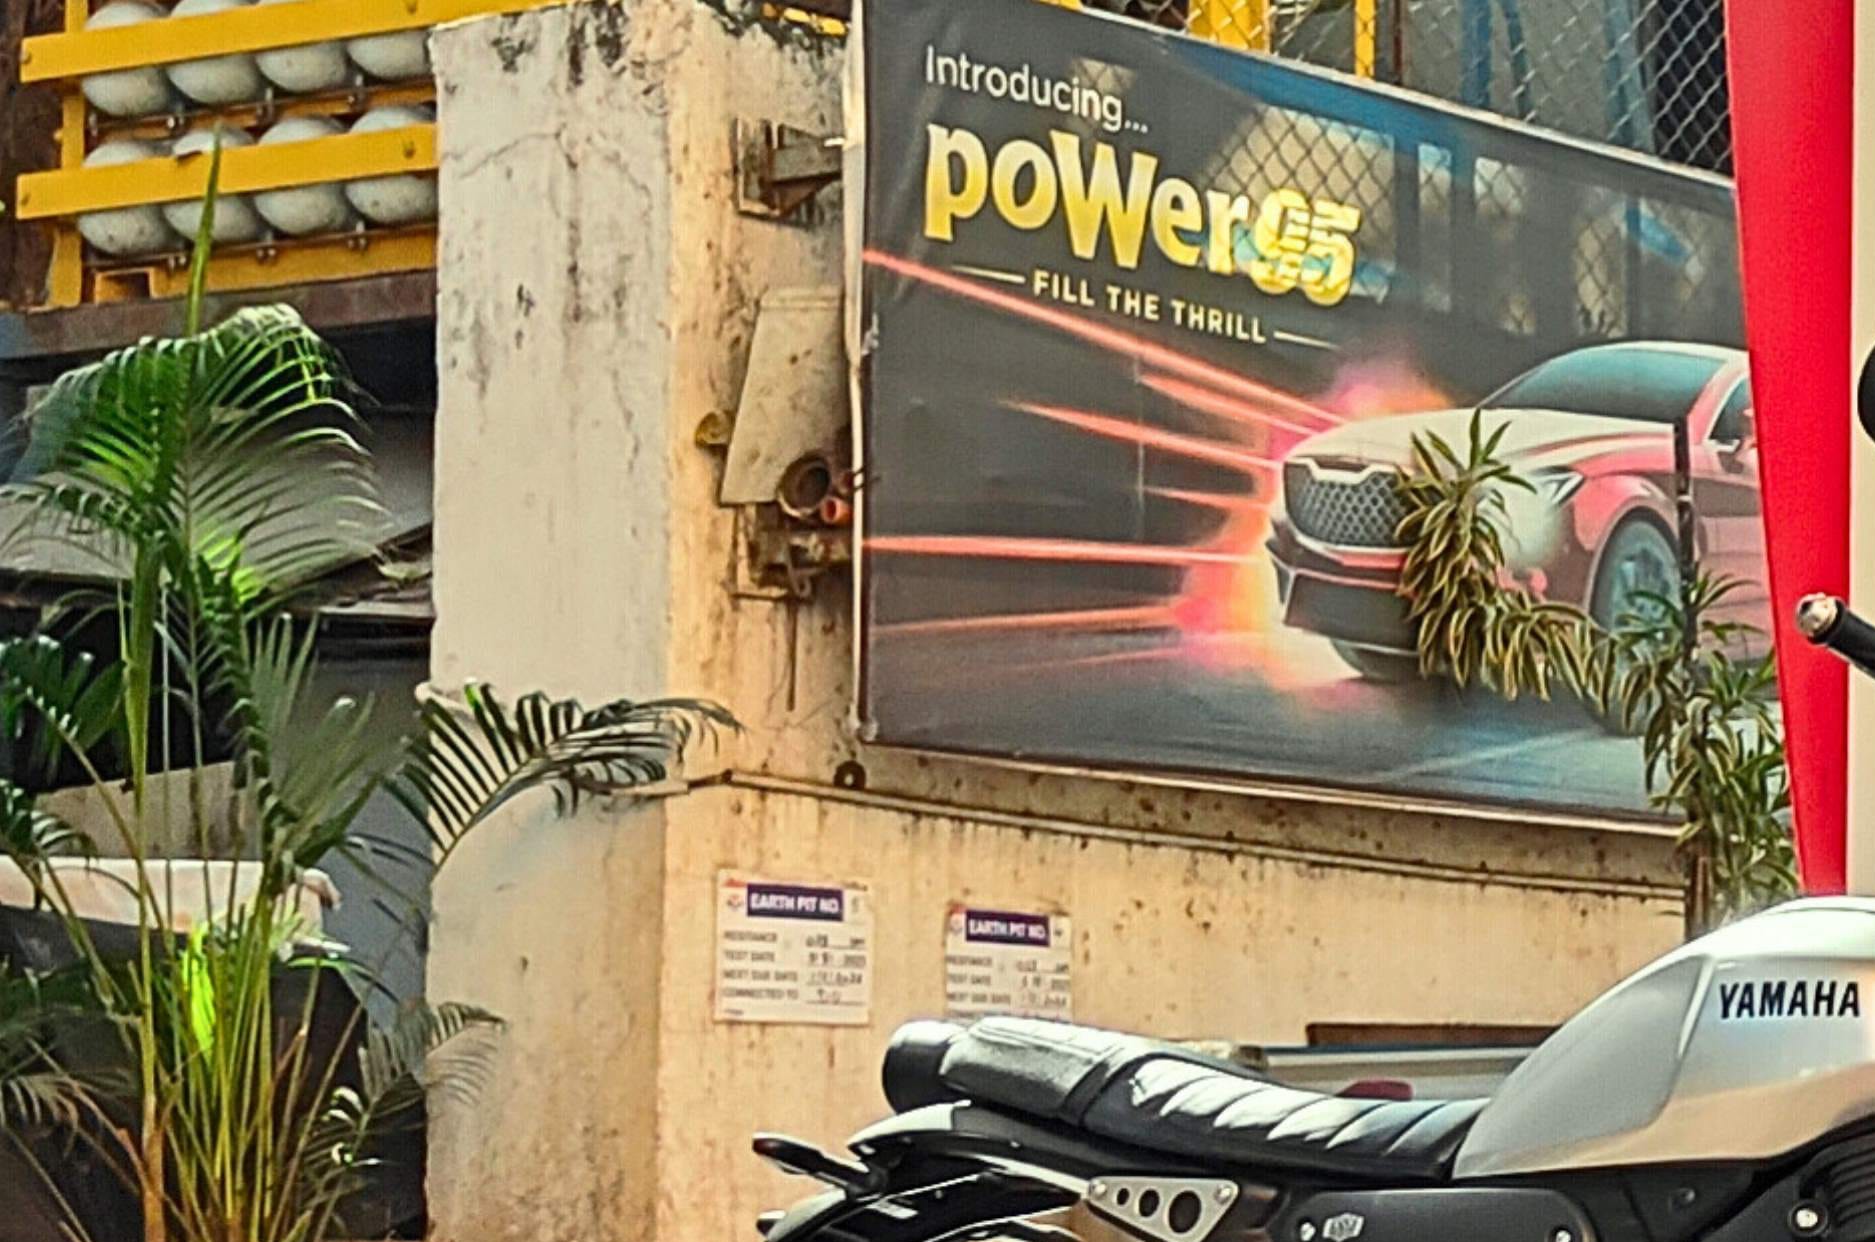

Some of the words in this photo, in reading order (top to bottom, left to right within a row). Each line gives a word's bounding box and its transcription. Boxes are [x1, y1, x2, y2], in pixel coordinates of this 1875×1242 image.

[925, 45, 1149, 133] Introducing...
[1031, 269, 1095, 308] FILL
[1106, 286, 1160, 321] THE
[1171, 301, 1266, 344] THRILL
[750, 892, 795, 911] EARTH
[797, 895, 817, 912] PIT
[969, 919, 1008, 936] EARTH
[1010, 921, 1027, 937] PIT
[1719, 981, 1860, 1019] YAMAHA
